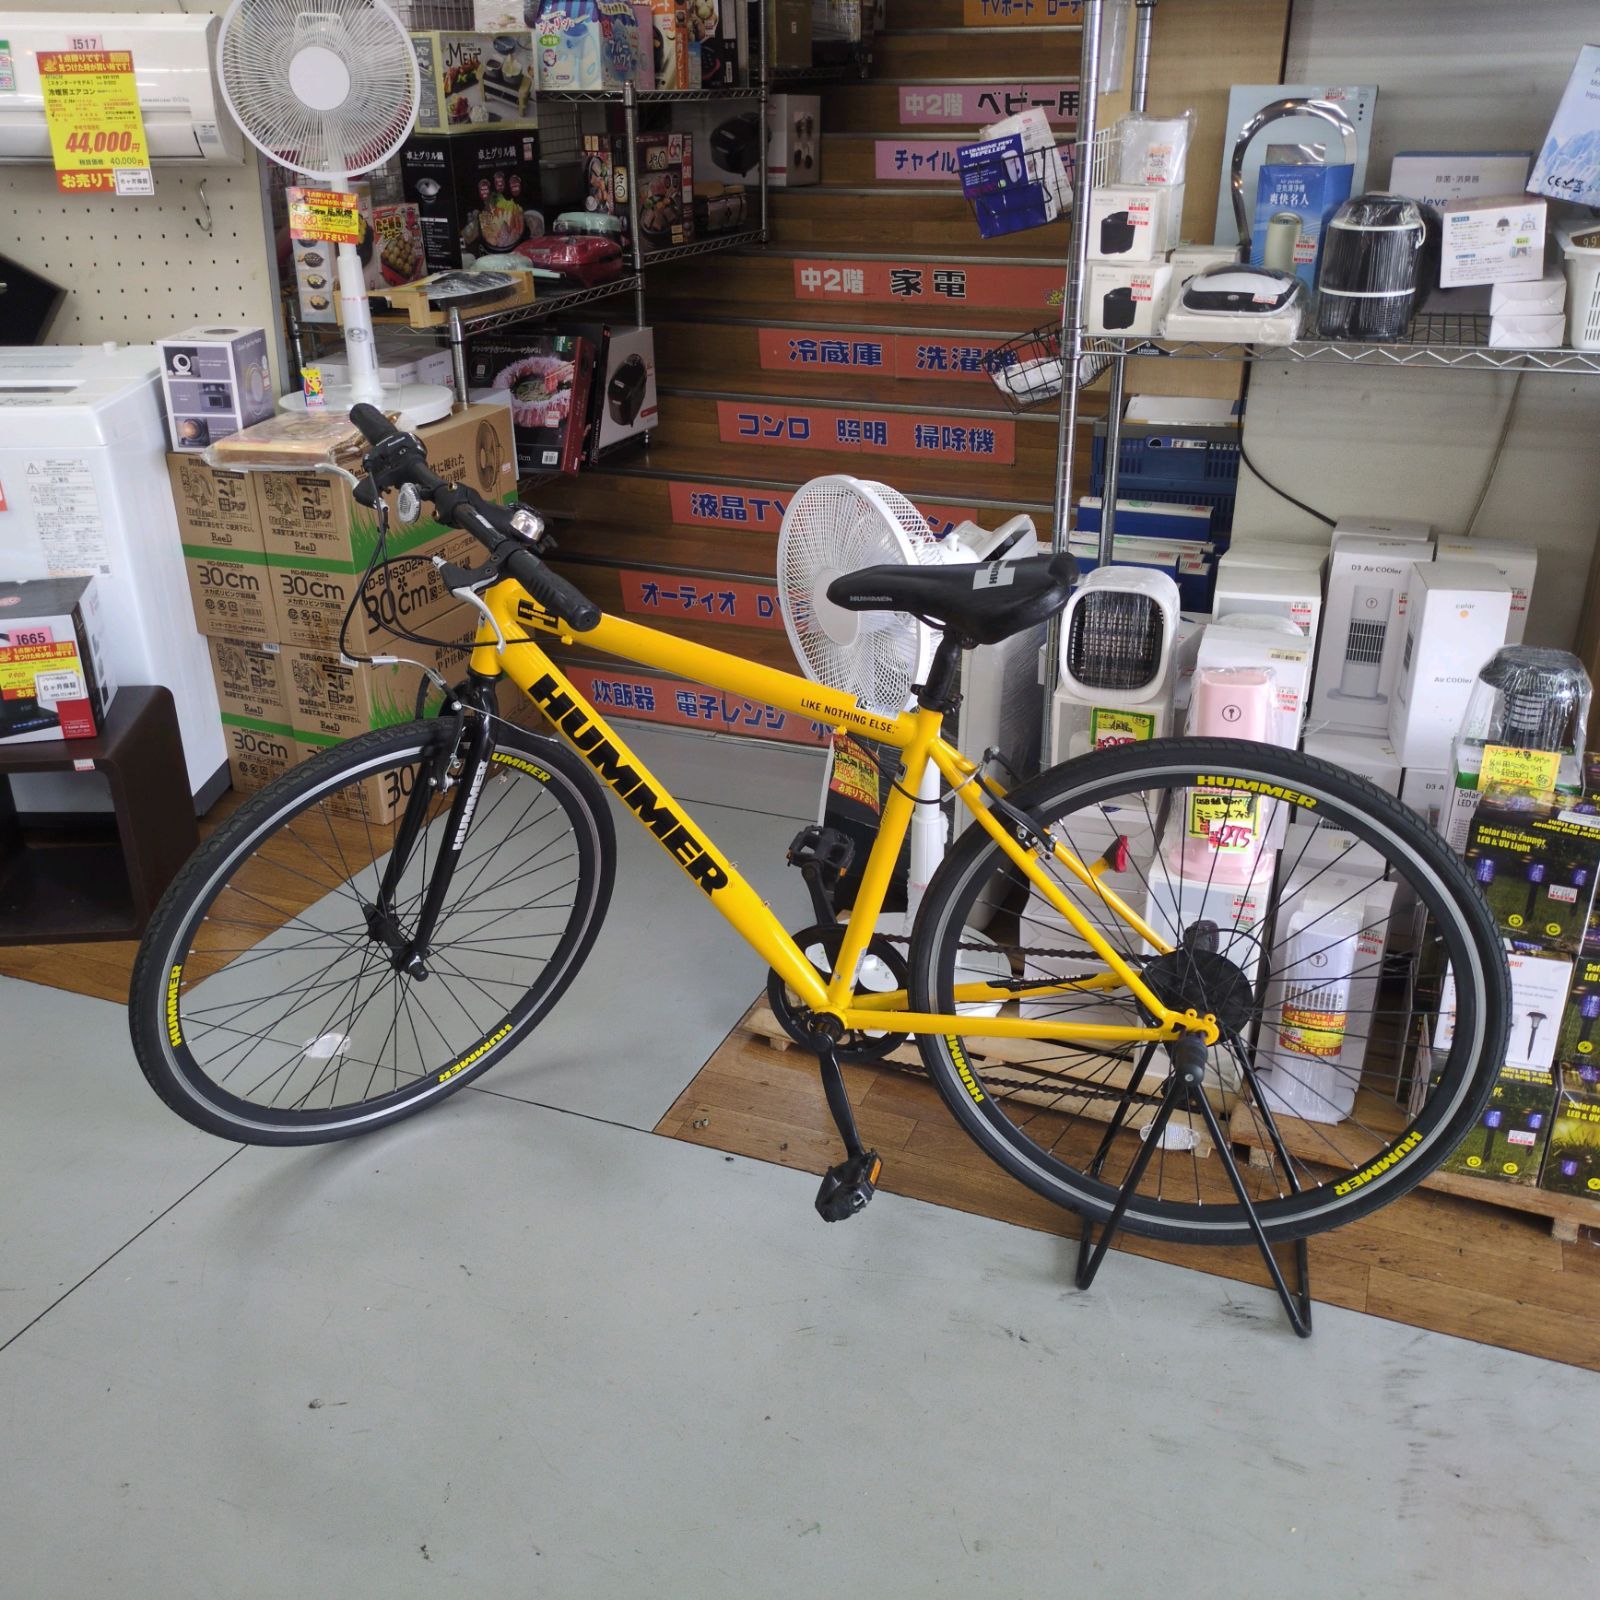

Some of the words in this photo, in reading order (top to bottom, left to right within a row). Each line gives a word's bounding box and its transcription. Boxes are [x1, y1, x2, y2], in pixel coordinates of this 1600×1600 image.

[905, 93, 963, 117] 中2階
[801, 268, 864, 294] 中2階
[890, 269, 967, 298] 家電
[789, 339, 883, 367] 冷蔵庫
[915, 344, 1018, 374] 洗濯機
[738, 414, 810, 440] コンロ
[836, 418, 888, 446] 照明
[914, 424, 995, 454] 掃除機
[197, 565, 260, 591] 30cm
[280, 574, 345, 600] 30cm
[641, 583, 736, 617] オーディオ
[592, 680, 655, 712] 炊飯器
[676, 691, 786, 731] 電子レンジ
[801, 699, 821, 711] LIKE
[824, 705, 866, 725] NOTHING
[232, 732, 289, 759] 30cm
[492, 752, 552, 783] UMMER
[528, 673, 728, 897] HUMMER
[1197, 775, 1317, 809] HUMMER
[1459, 790, 1480, 798] Solar
[452, 760, 489, 850] HUMMER
[1457, 800, 1472, 808] LED
[1477, 835, 1490, 844] LED
[1499, 840, 1510, 848] UV
[1510, 842, 1531, 853] Light
[1478, 826, 1499, 836] Solar
[1501, 830, 1516, 841] Bug
[1518, 833, 1546, 845] Zapper
[171, 964, 182, 1048] HUMMER
[439, 1023, 513, 1084] HUMMER
[1333, 1131, 1423, 1196] HUMMER
